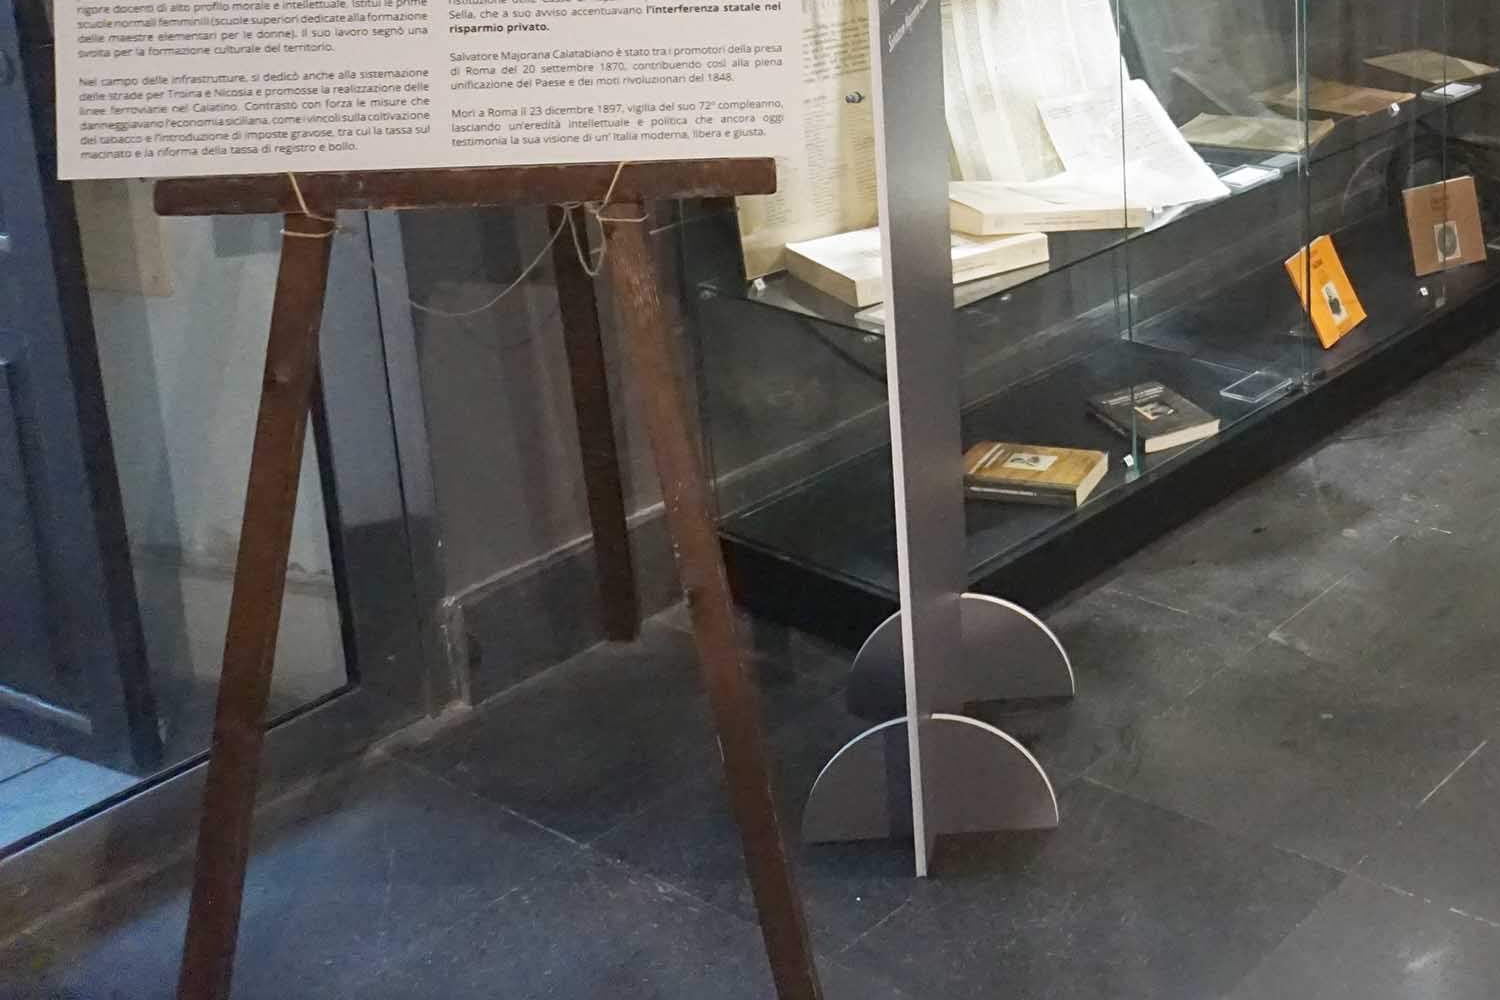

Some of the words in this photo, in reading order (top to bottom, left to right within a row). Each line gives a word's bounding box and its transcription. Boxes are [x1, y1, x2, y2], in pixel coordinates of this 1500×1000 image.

[448, 9, 476, 20] Sella,
[479, 9, 499, 19] che
[512, 10, 531, 18] suo
[535, 9, 567, 17] avviso
[571, 7, 642, 16] accentuavano
[646, 4, 719, 14] l'interferenza
[723, 2, 761, 12] statale
[764, 1, 781, 11] nel
[449, 24, 504, 35] risparmio
[506, 22, 549, 34] privato.
